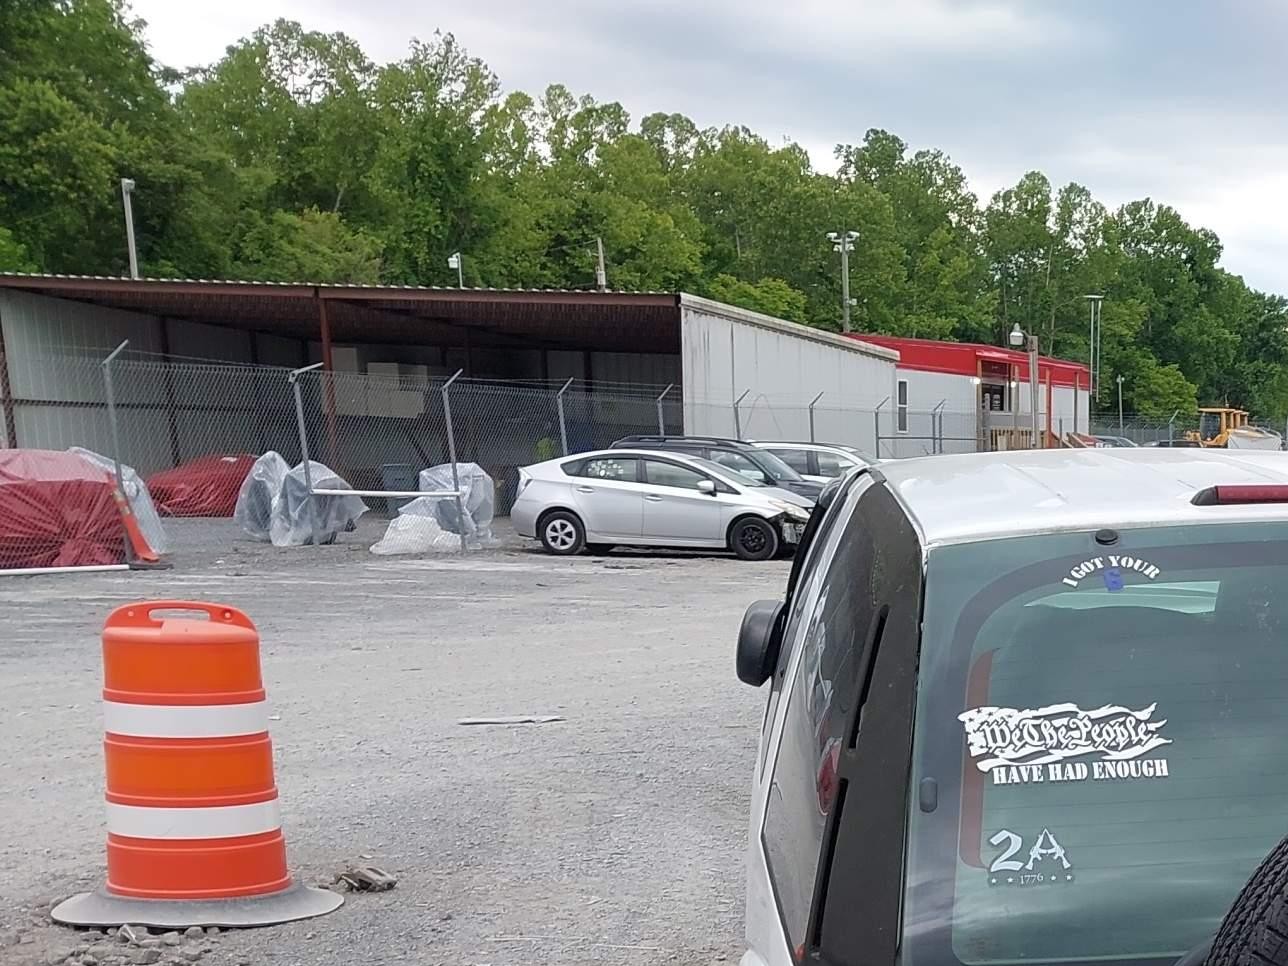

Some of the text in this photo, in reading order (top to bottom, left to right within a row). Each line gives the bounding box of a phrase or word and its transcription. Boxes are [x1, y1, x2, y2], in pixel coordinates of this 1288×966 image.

[1062, 555, 1161, 588] I GOT YOUR
[980, 714, 1158, 753] We The People
[992, 759, 1169, 785] HAVE HAD ENOUGH
[989, 827, 1072, 872] 2A
[1020, 872, 1044, 885] 1776
